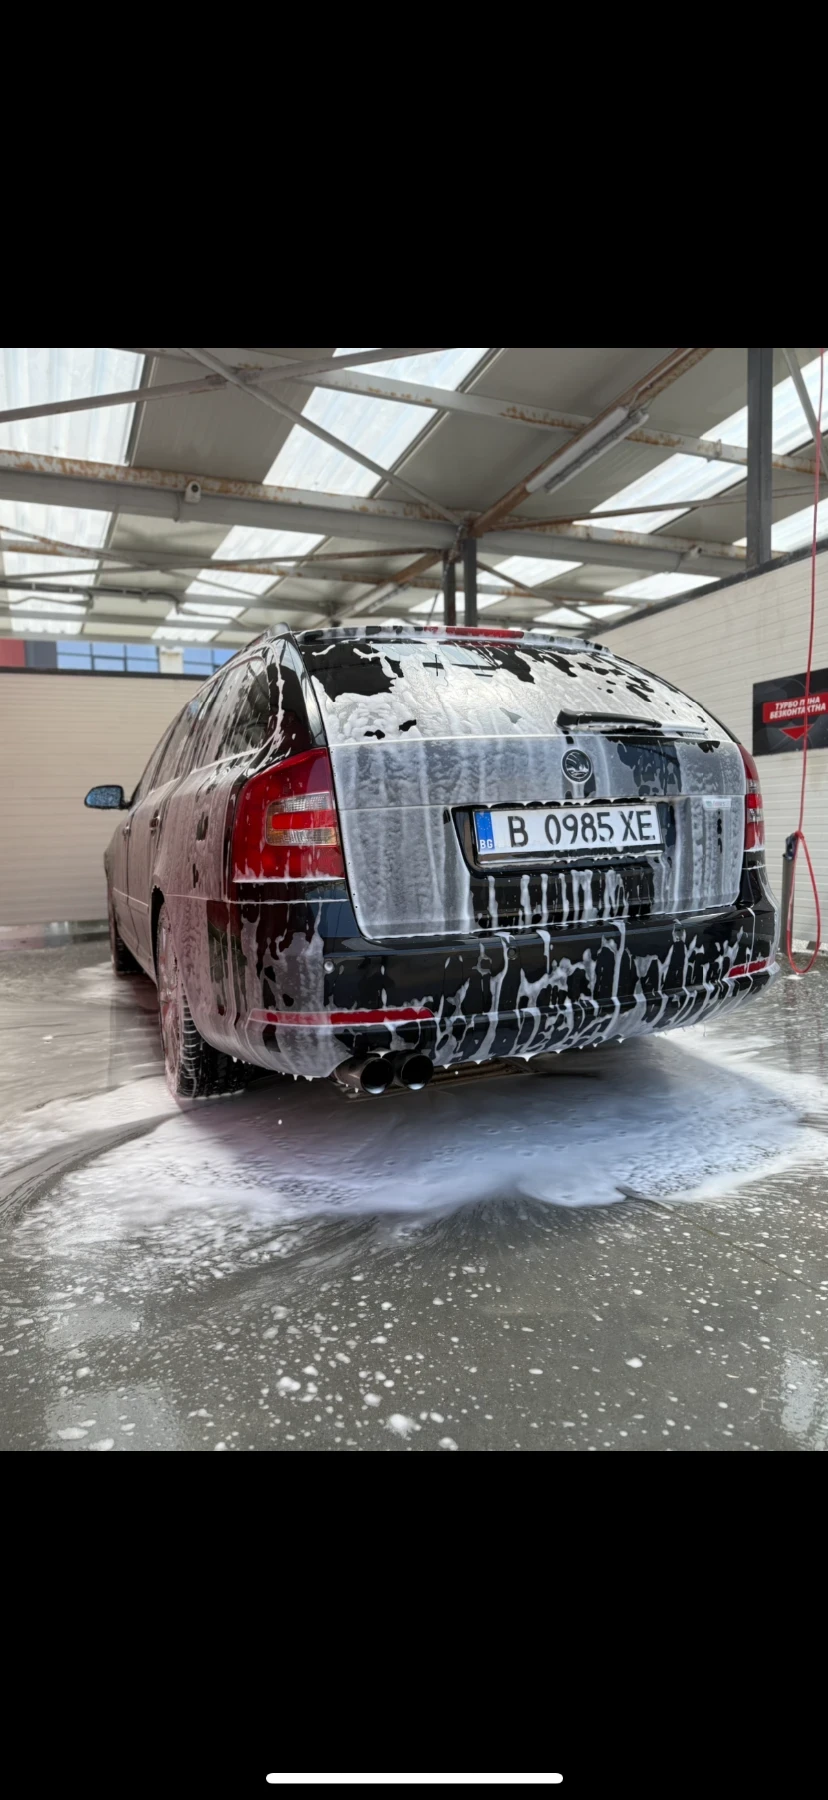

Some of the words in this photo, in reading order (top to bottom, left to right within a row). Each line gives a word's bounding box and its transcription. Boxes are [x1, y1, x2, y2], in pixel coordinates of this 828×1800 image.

[775, 701, 798, 710] ТУРБО
[507, 815, 529, 848] B
[544, 812, 614, 845] 0985
[618, 810, 656, 842] XE
[480, 839, 493, 849] BG
